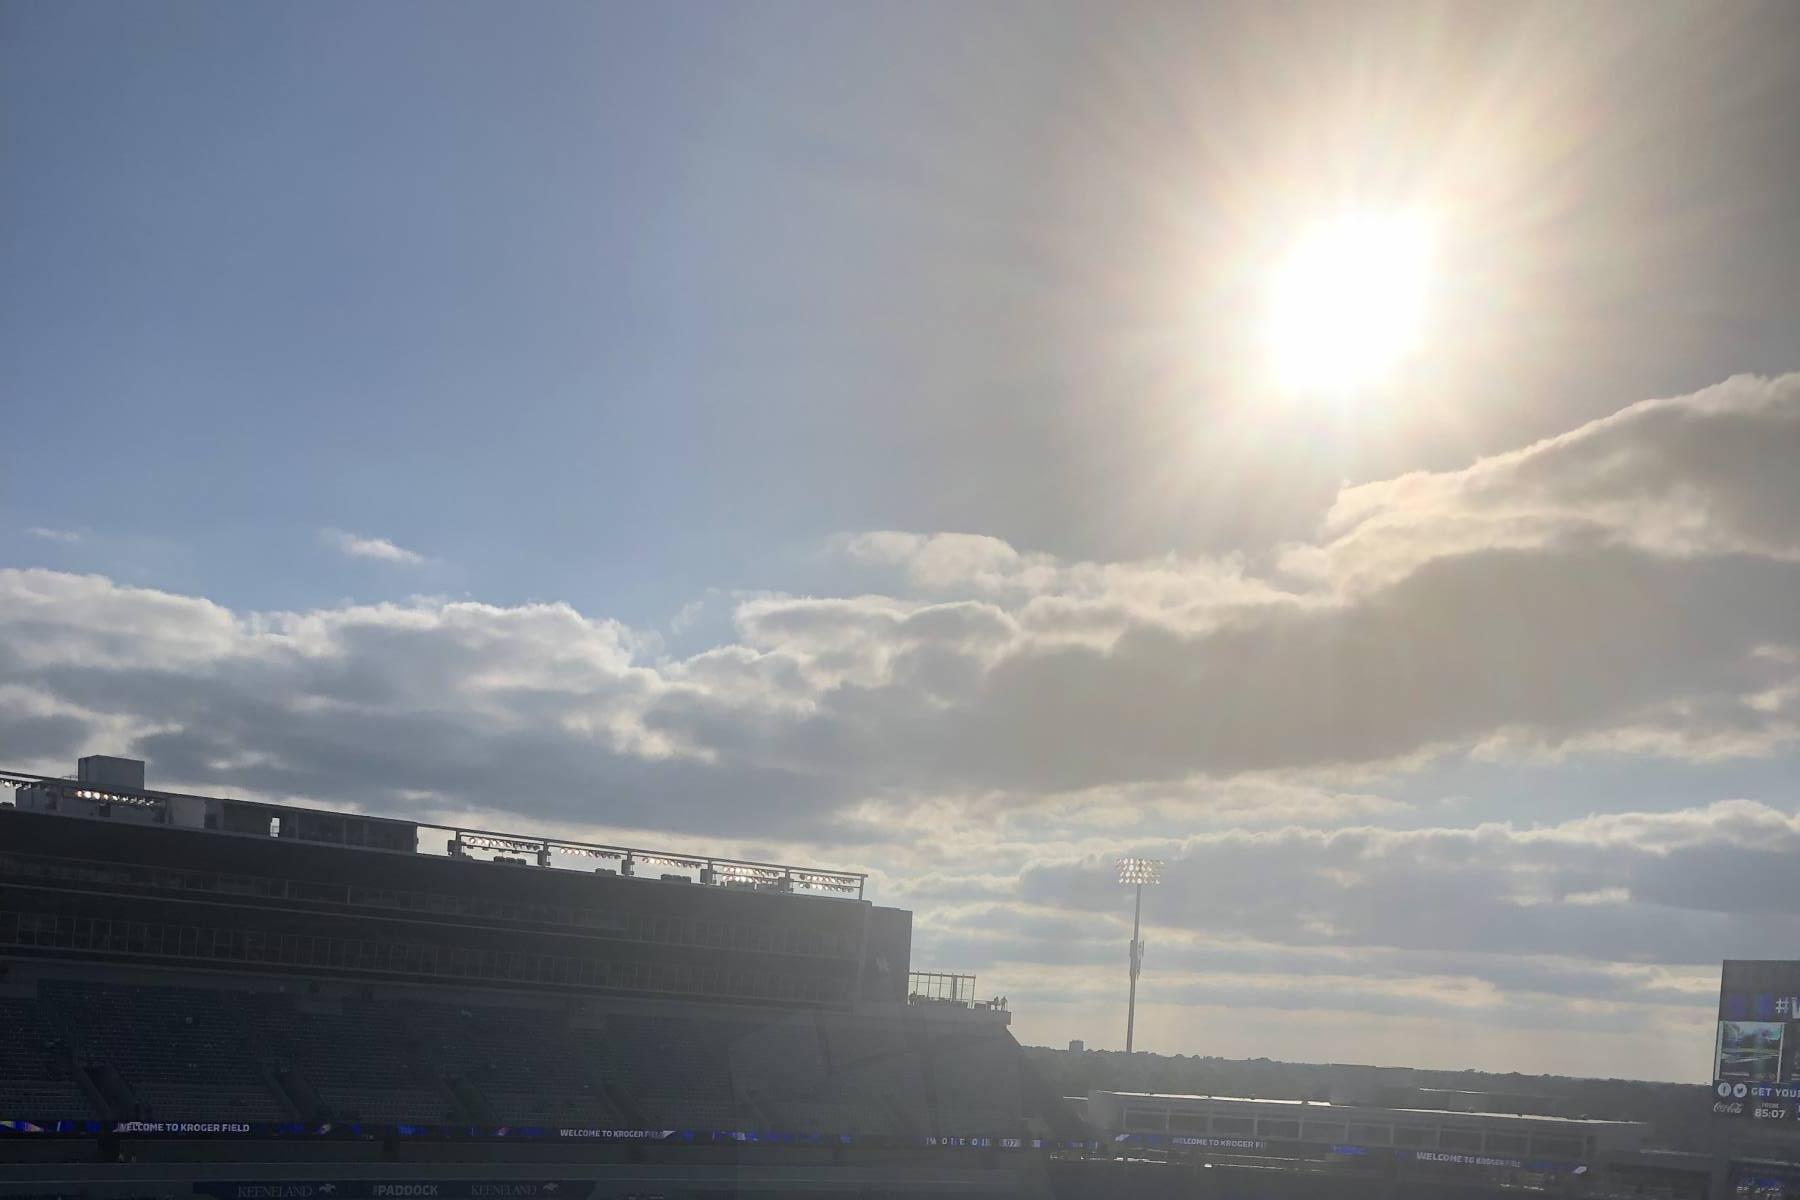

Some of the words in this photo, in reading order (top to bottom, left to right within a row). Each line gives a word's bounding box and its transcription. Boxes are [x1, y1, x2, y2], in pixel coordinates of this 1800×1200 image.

[1751, 1088, 1771, 1097] GET
[1754, 1108, 1785, 1119] 85:07
[119, 1122, 164, 1132] WELCOME
[166, 1123, 179, 1132] TO
[180, 1123, 220, 1133] KROGER
[222, 1124, 250, 1133] FIELD
[560, 1129, 601, 1138] WELCOME
[602, 1130, 612, 1138] TO
[613, 1130, 643, 1139] KROGER
[1209, 1139, 1219, 1147] TO
[1220, 1139, 1254, 1149] KROGER
[1416, 1151, 1463, 1164] WELCOME
[238, 1185, 313, 1199] KEENELAND
[378, 1184, 438, 1197] PADDOCK
[471, 1184, 538, 1197] KEENELAND
